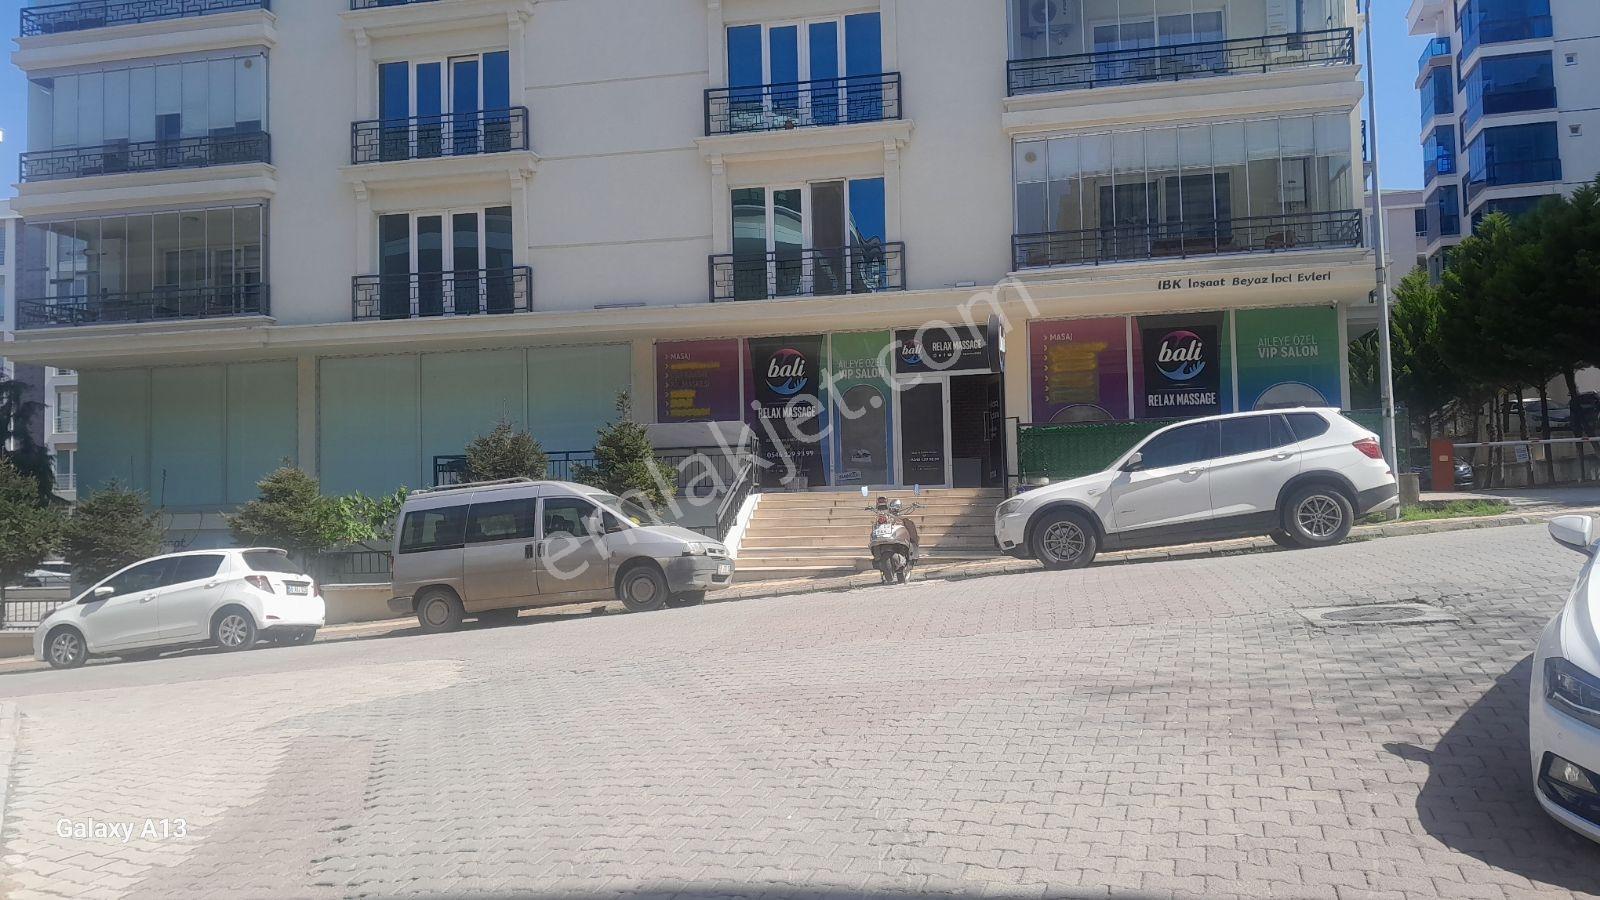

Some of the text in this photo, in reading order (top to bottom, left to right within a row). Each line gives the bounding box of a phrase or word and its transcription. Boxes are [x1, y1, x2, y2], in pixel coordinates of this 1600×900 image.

[1232, 277, 1268, 287] Beyaz
[1049, 333, 1073, 342] MASAJ
[932, 340, 982, 352] RELAX MASSAGE
[1158, 340, 1203, 362] bali
[1257, 345, 1319, 359] VIP SALON
[670, 353, 691, 361] MASAJ
[767, 357, 806, 378] bali
[1148, 392, 1217, 407] RELAX MASSAGE
[758, 406, 816, 419] RELAX MASSAGE
